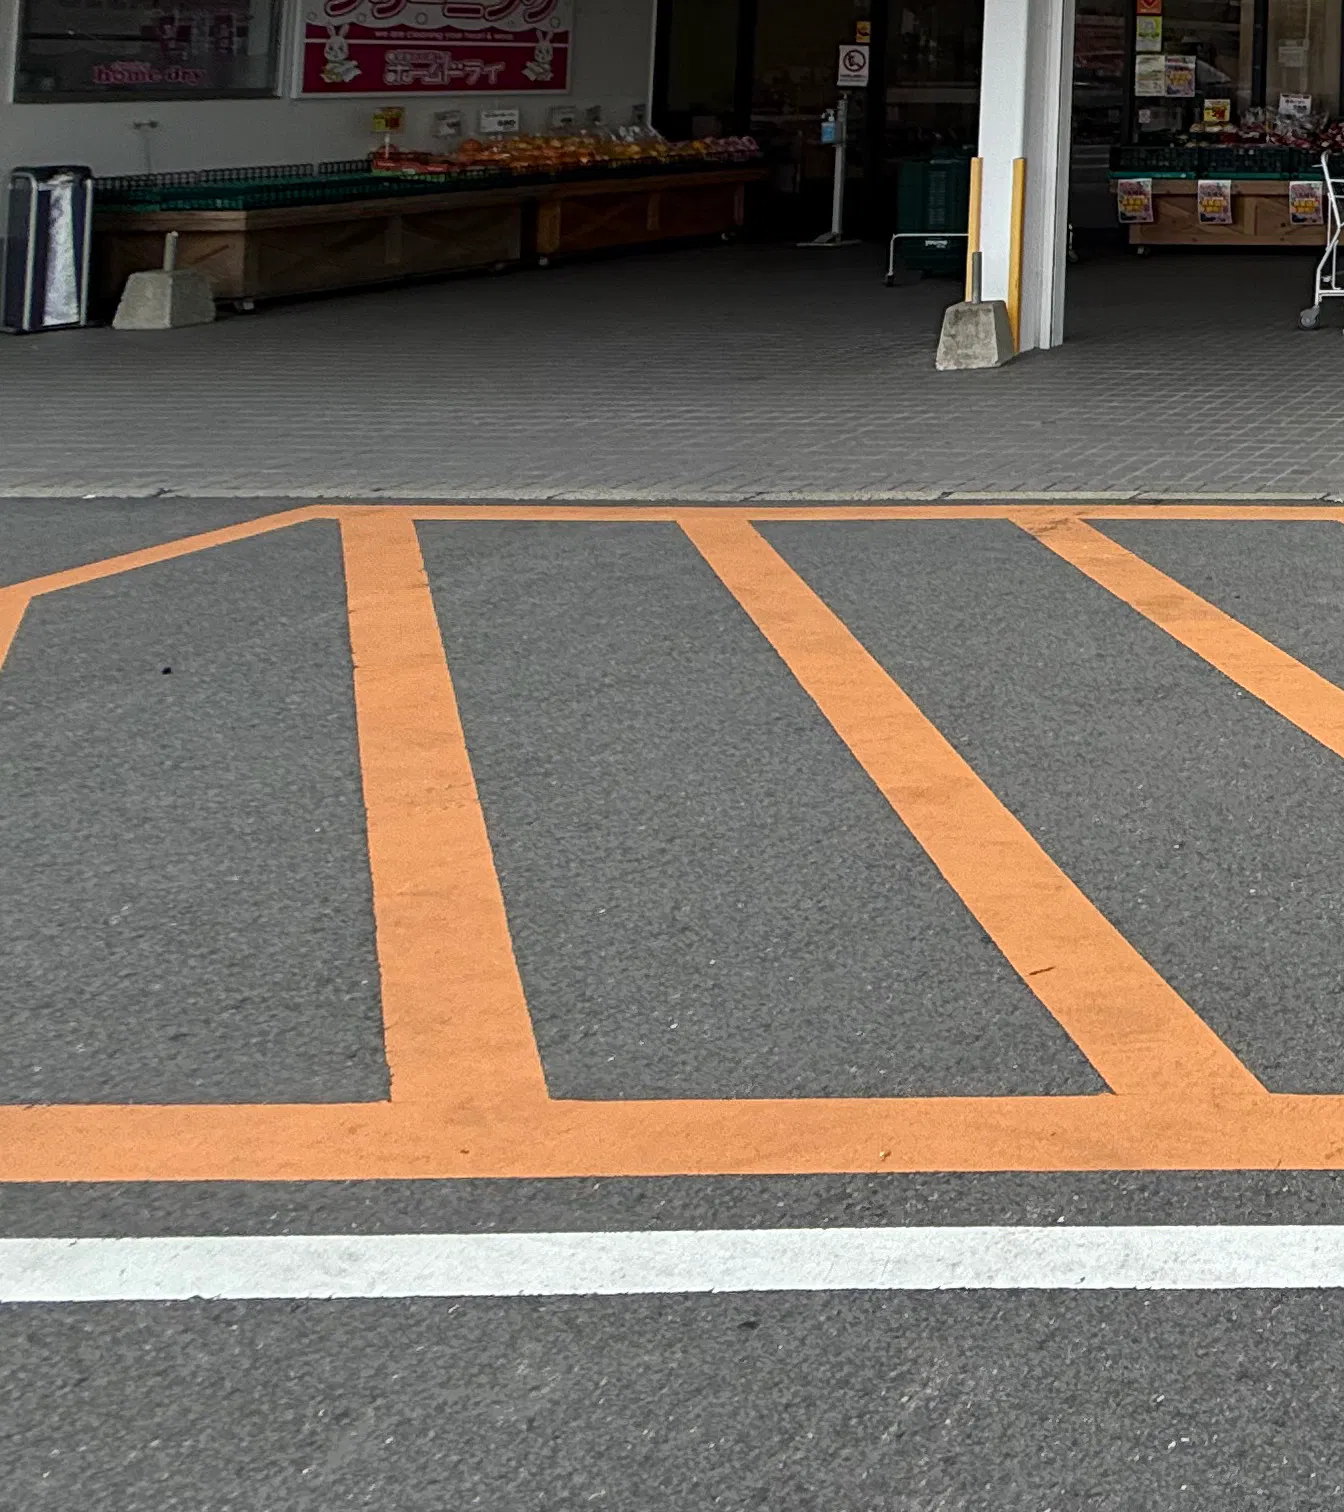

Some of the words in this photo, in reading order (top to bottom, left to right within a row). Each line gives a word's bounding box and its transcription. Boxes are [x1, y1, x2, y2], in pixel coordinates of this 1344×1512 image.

[383, 51, 506, 86] ホームドライ
